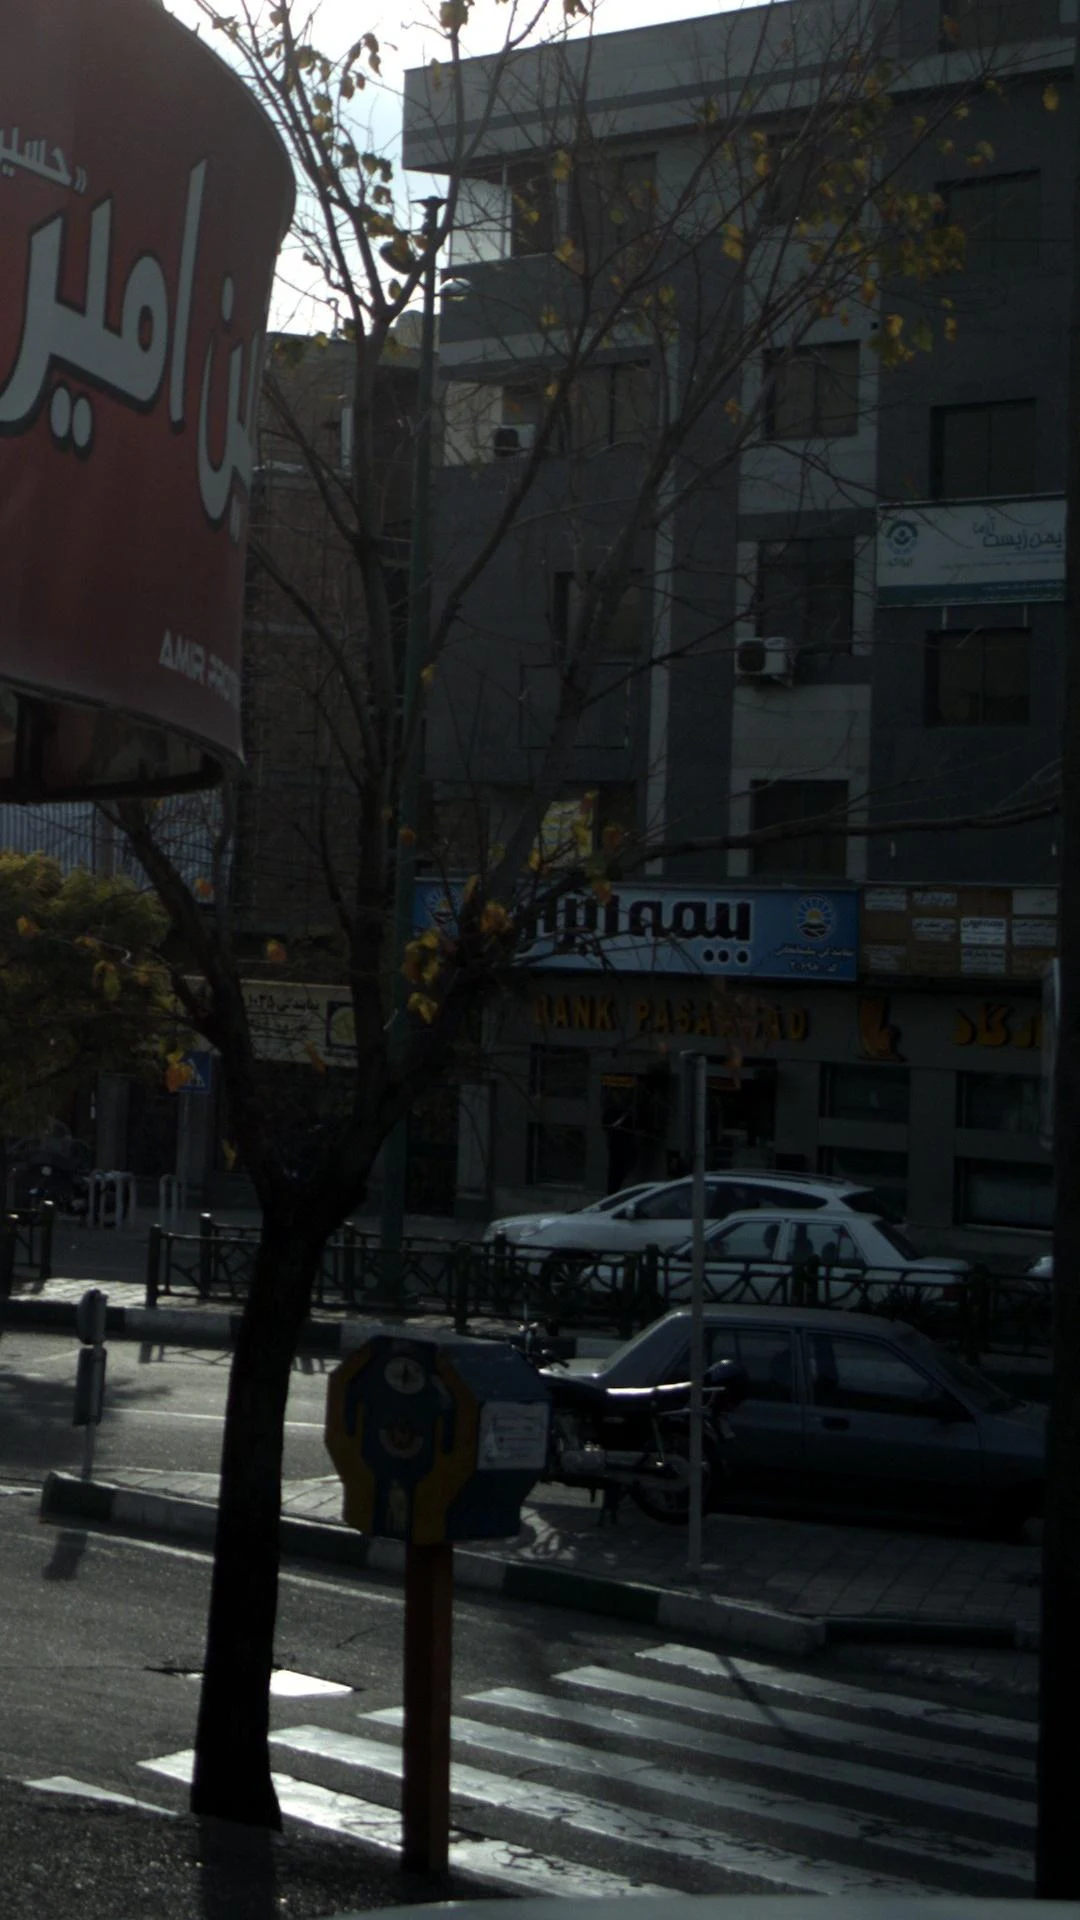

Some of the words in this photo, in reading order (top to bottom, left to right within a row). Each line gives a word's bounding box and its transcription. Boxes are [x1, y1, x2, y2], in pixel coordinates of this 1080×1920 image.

[158, 628, 205, 689] AMIR
[627, 898, 751, 964] بیمه
[531, 995, 614, 1031] BANK
[949, 1002, 1041, 1050] رگاد
